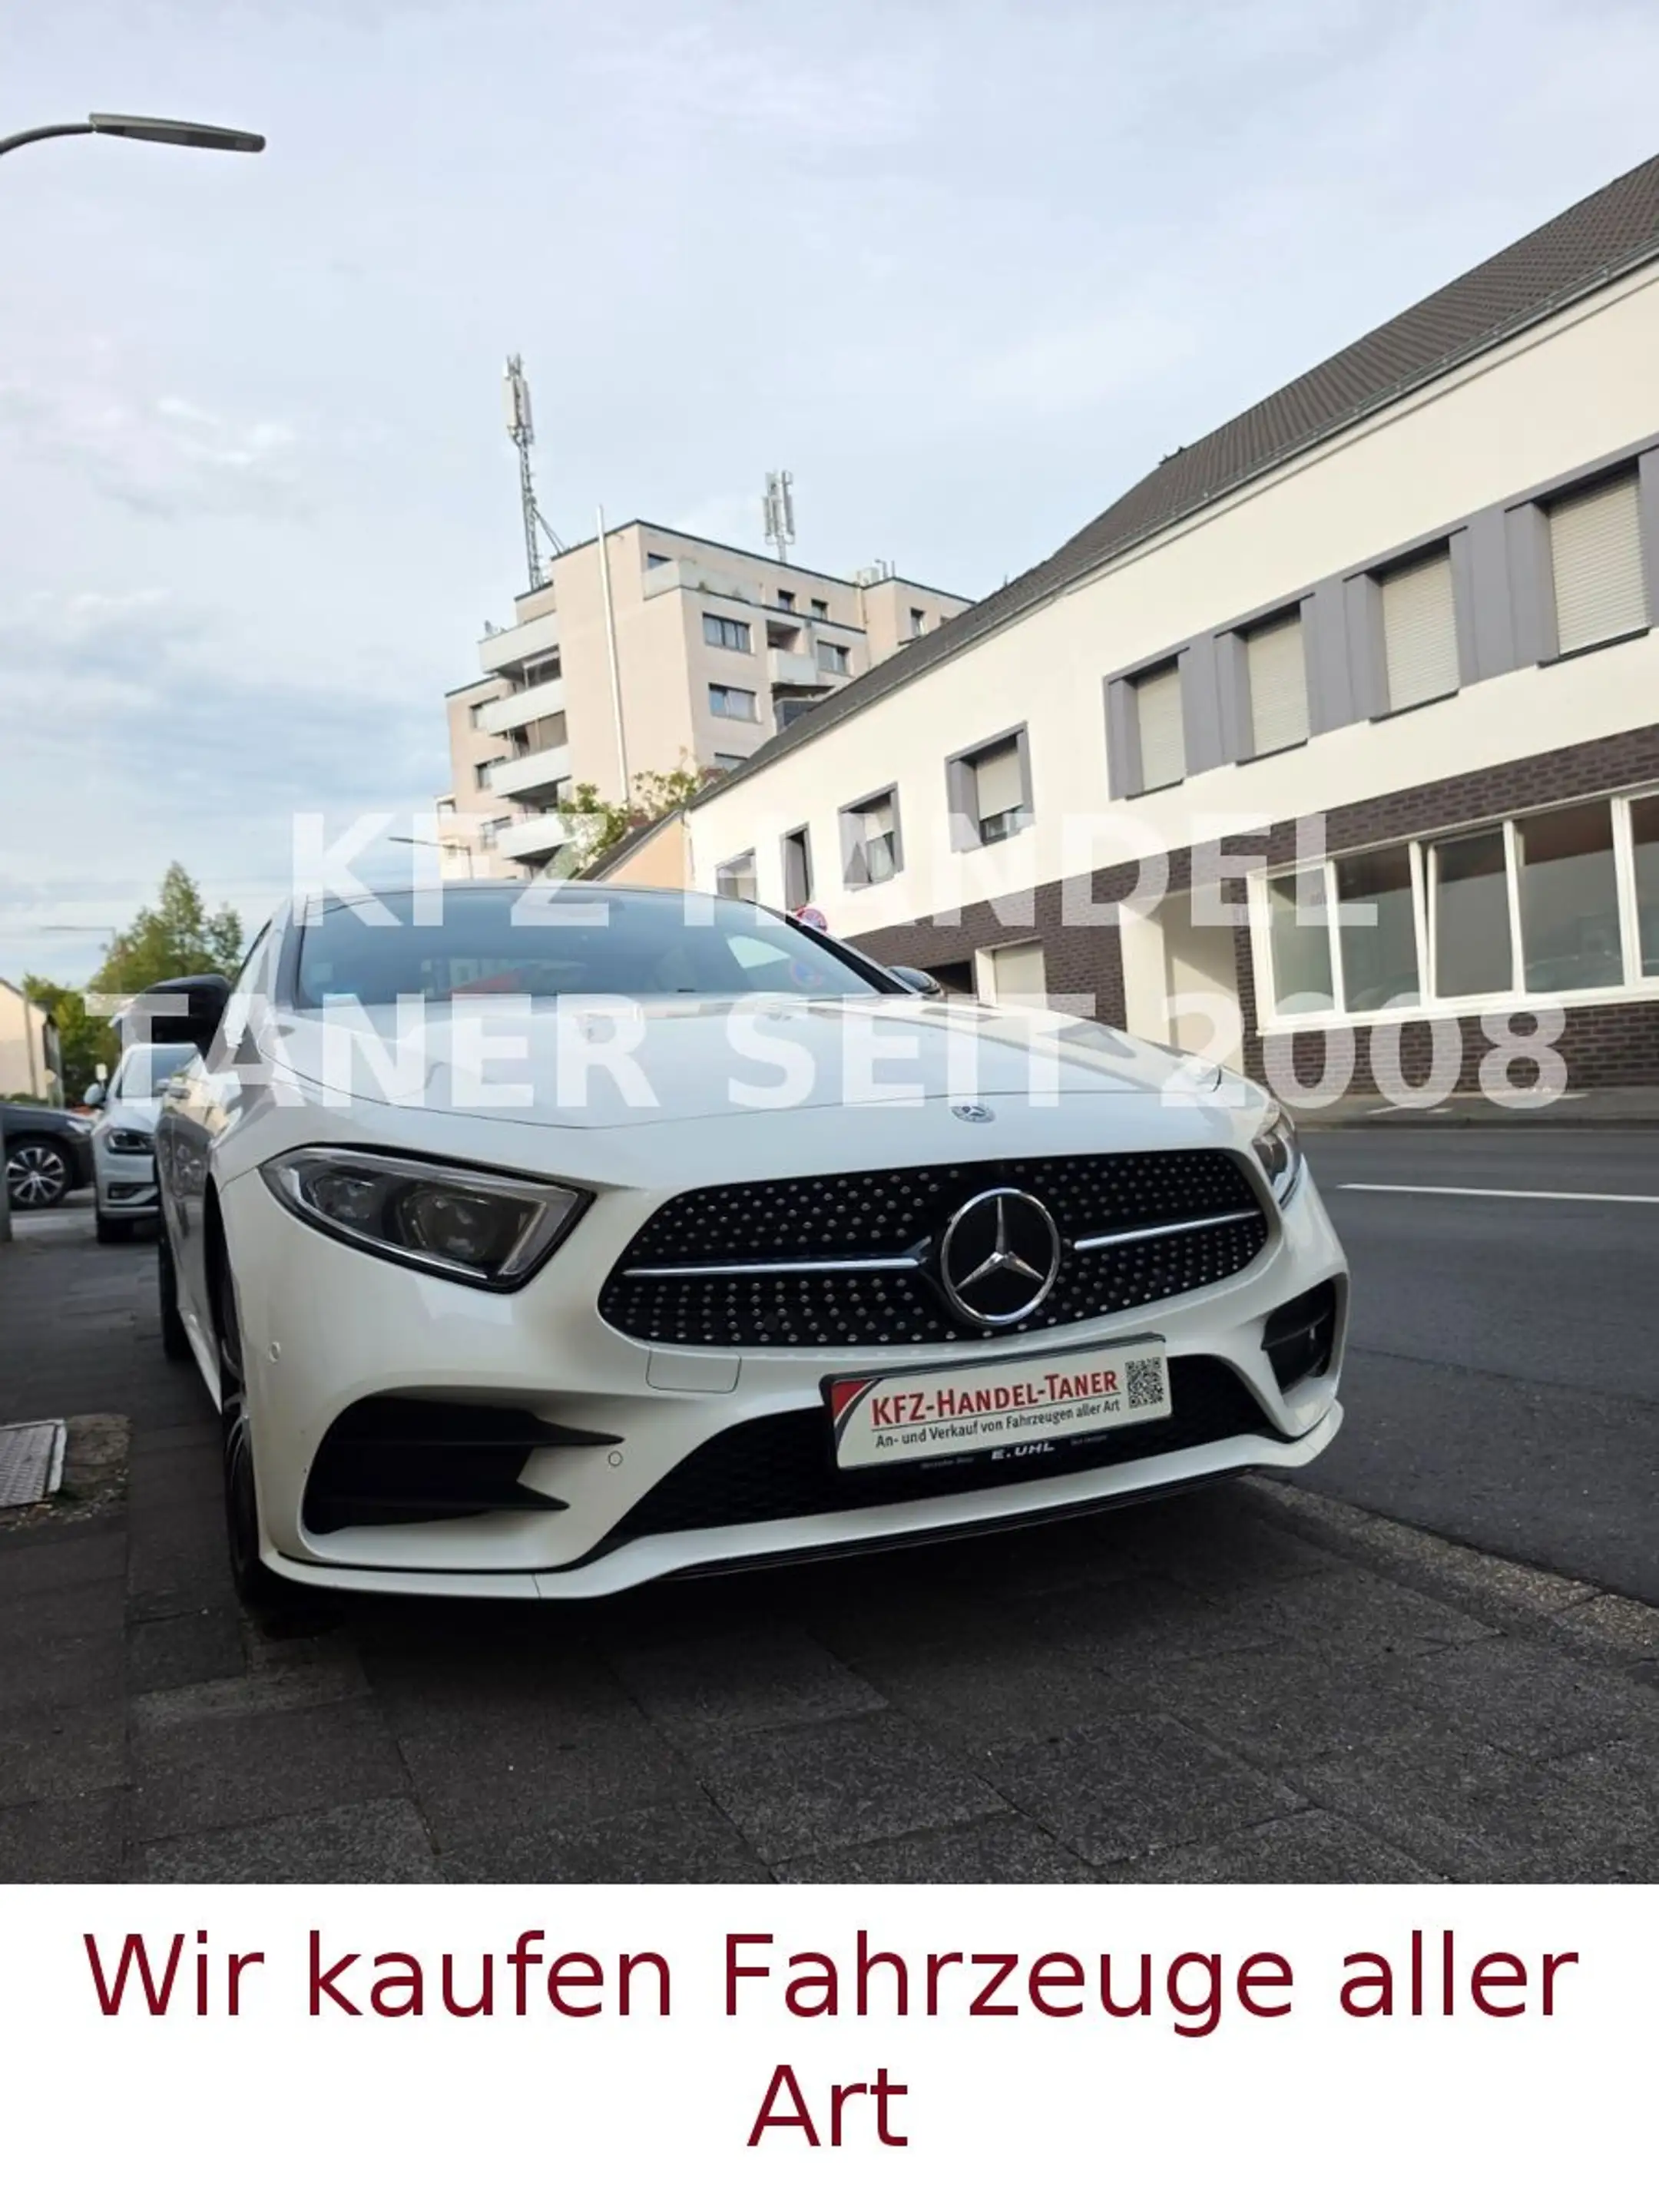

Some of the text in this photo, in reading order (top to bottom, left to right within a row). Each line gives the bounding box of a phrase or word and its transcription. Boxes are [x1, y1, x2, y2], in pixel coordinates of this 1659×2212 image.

[876, 1399, 1121, 1449] An- und Verkauf von Fahrzeugen aller Art
[991, 1442, 1055, 1461] E.UHL
